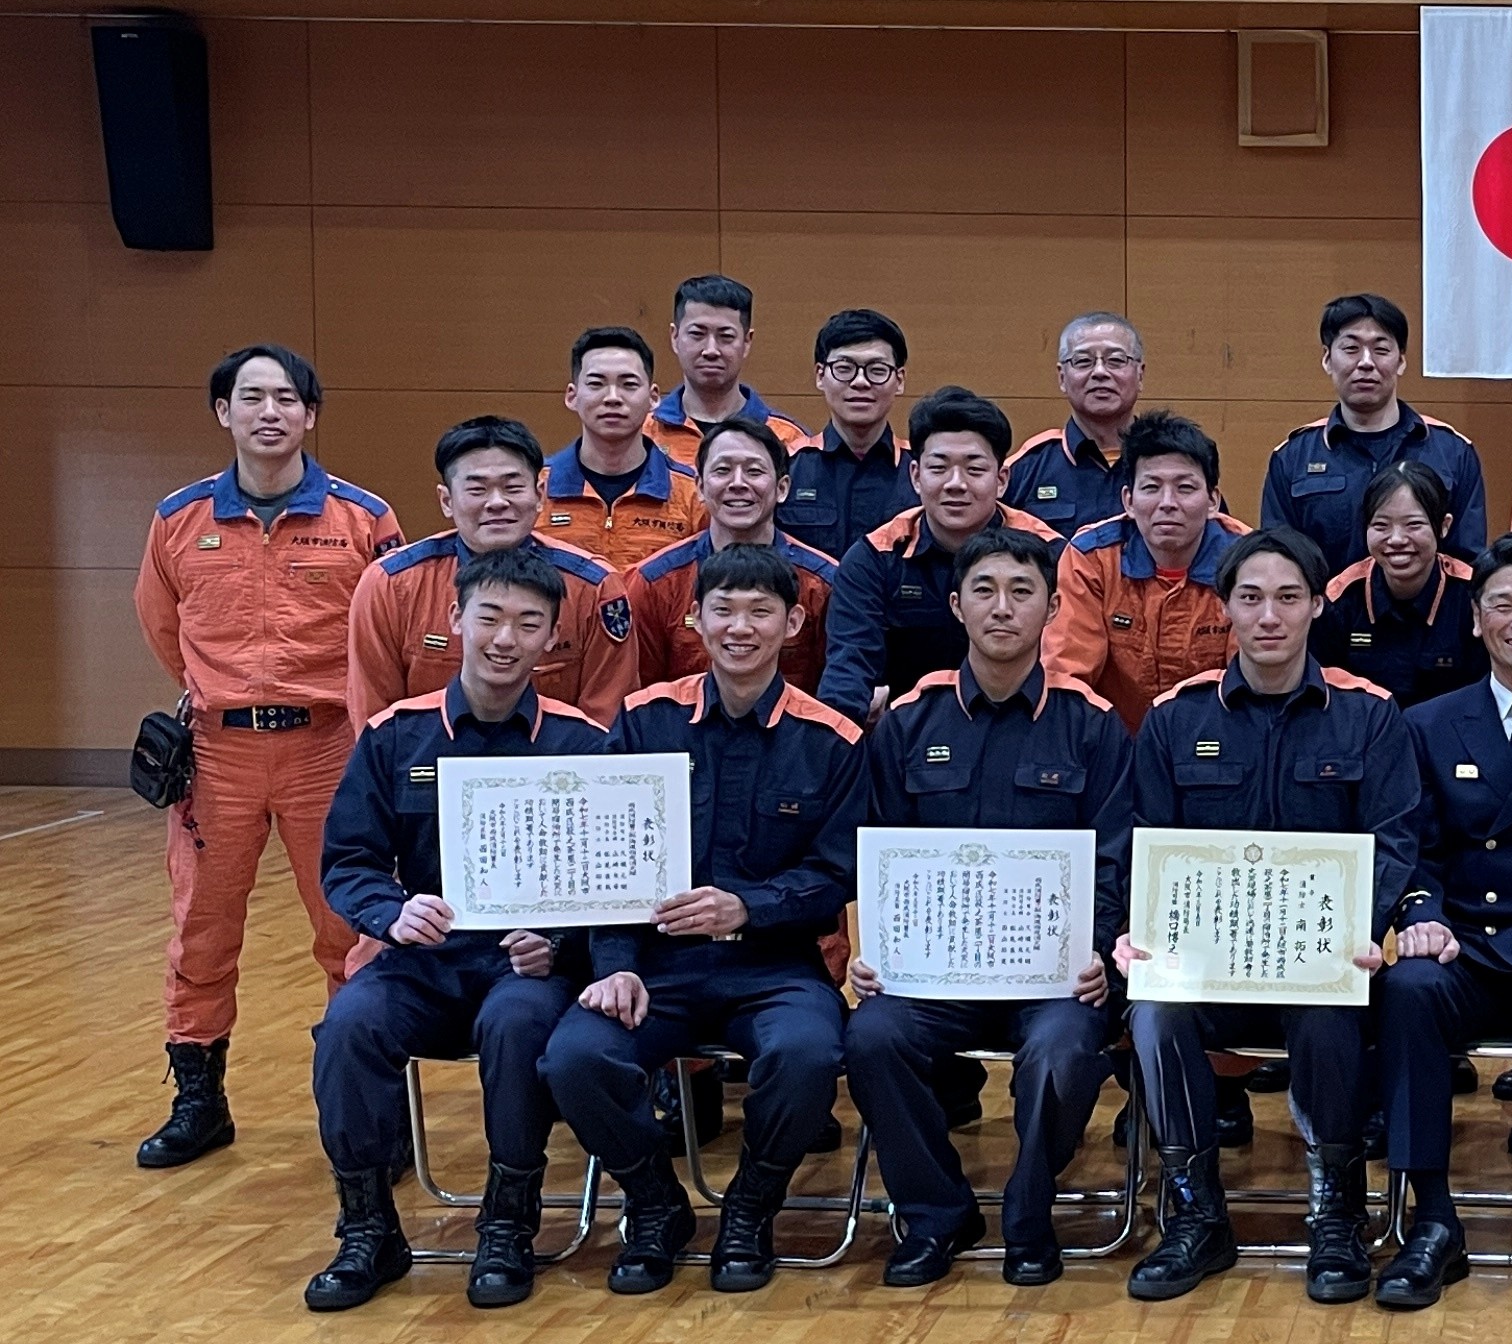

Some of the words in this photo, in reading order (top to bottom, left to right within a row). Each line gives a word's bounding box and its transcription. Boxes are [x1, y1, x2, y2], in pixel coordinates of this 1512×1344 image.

[643, 817, 655, 862] 表彰状
[1047, 893, 1060, 937] 表彰状
[1316, 894, 1333, 954] 表彰状
